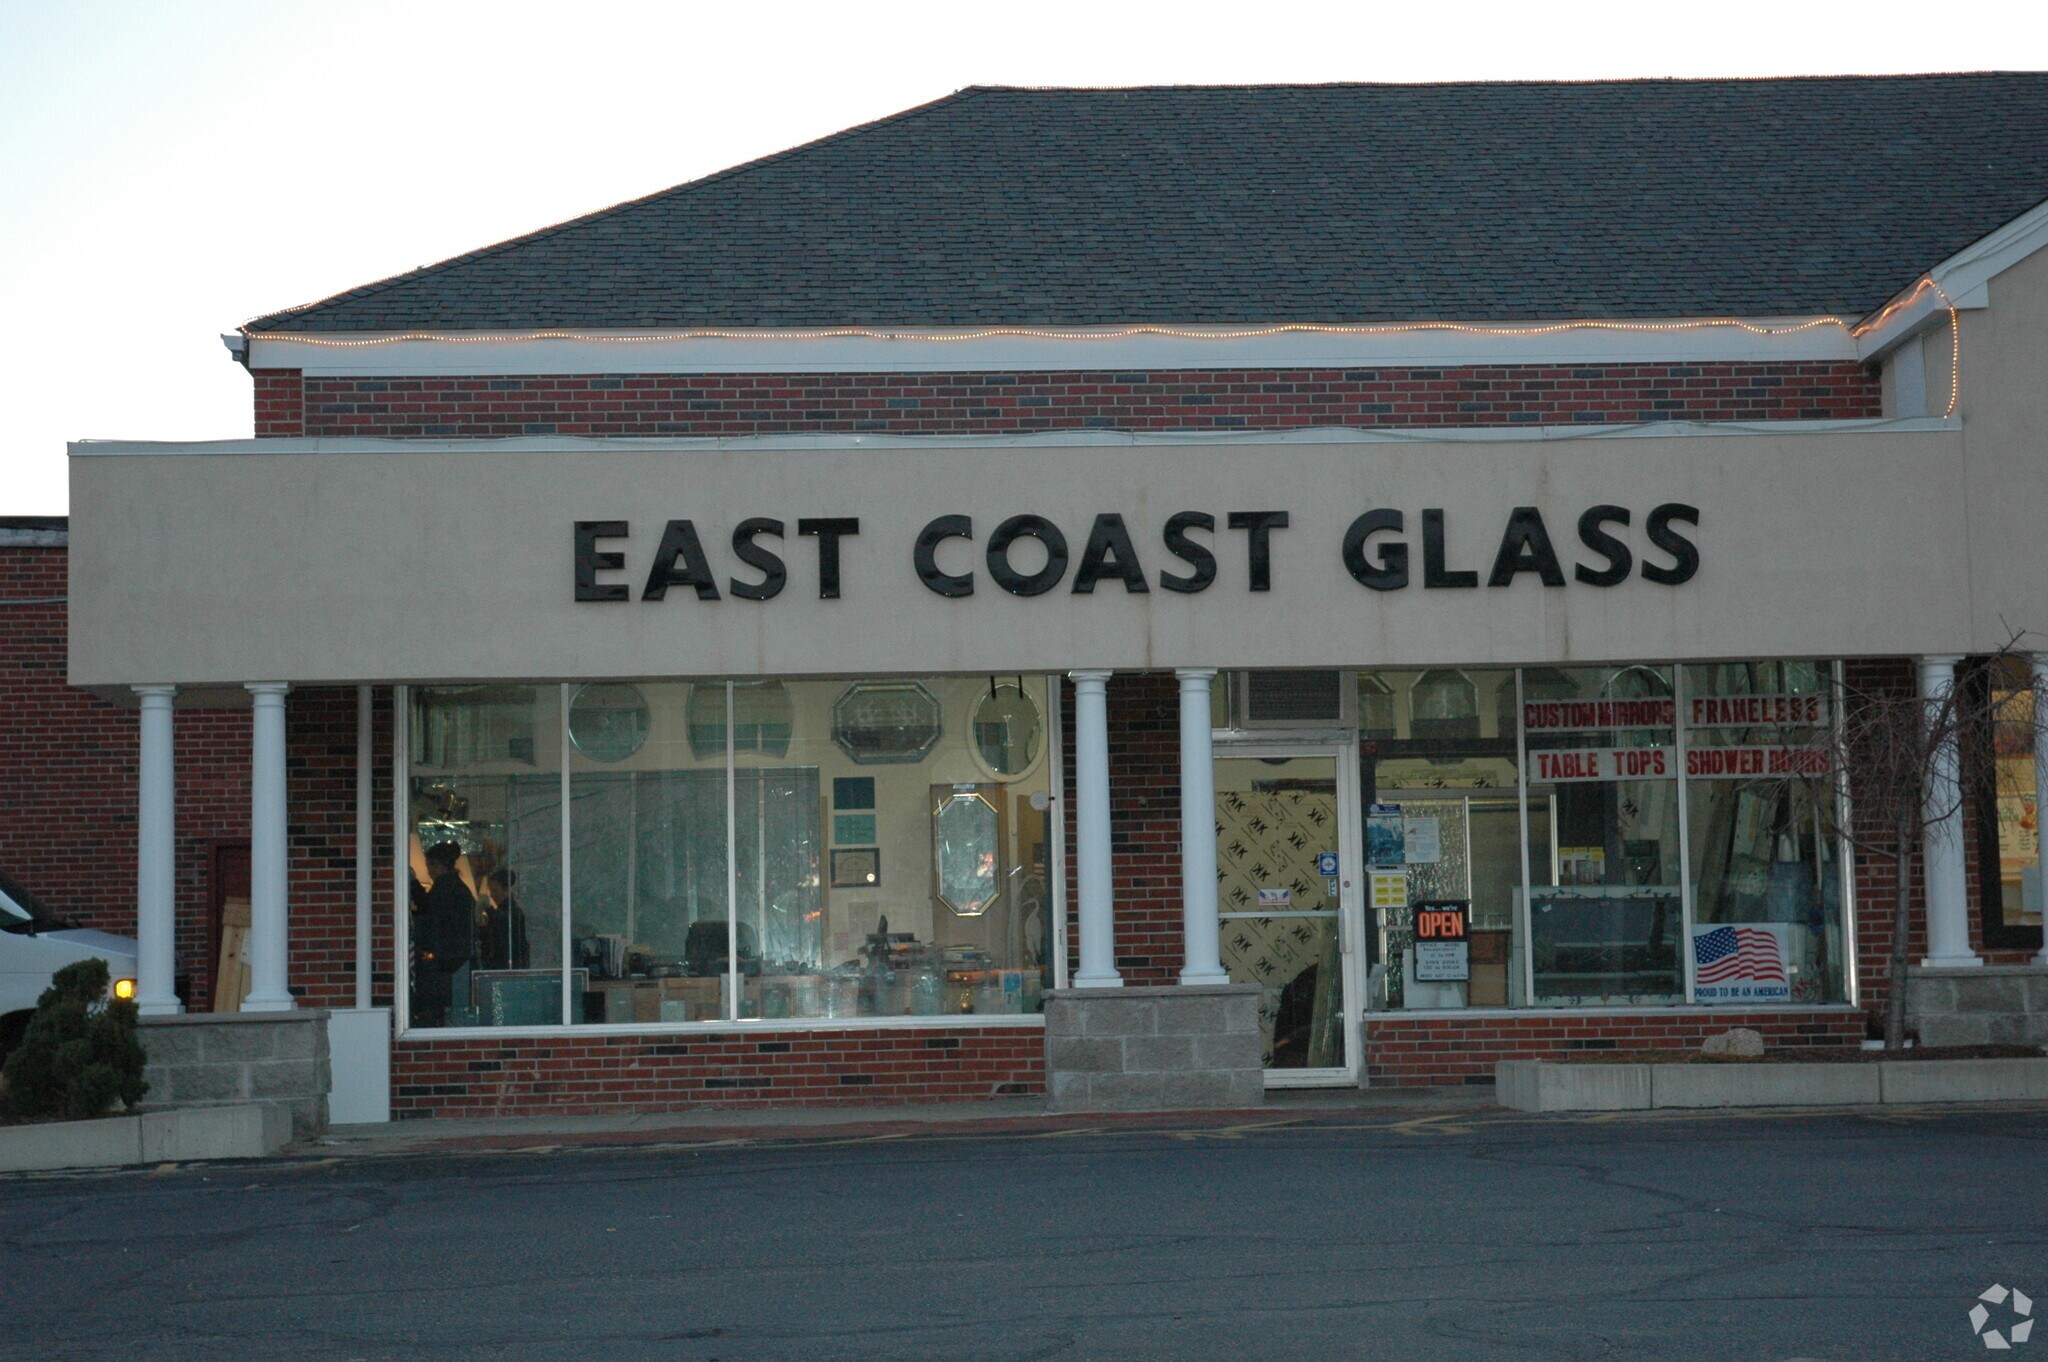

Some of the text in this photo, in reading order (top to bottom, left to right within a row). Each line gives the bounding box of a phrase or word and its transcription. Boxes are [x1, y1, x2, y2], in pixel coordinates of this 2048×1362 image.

[574, 503, 1699, 604] EAST COAST GLASS
[1525, 699, 1673, 728] CUSTOM MIRRORS
[1692, 697, 1819, 725] FRAMELESS
[1538, 749, 1666, 779] TABLE TOPS
[1687, 749, 1764, 775] SHOWER
[1418, 911, 1464, 938] OPEN
[1694, 986, 1789, 998] PROUD TO BE AN AMERICAN
